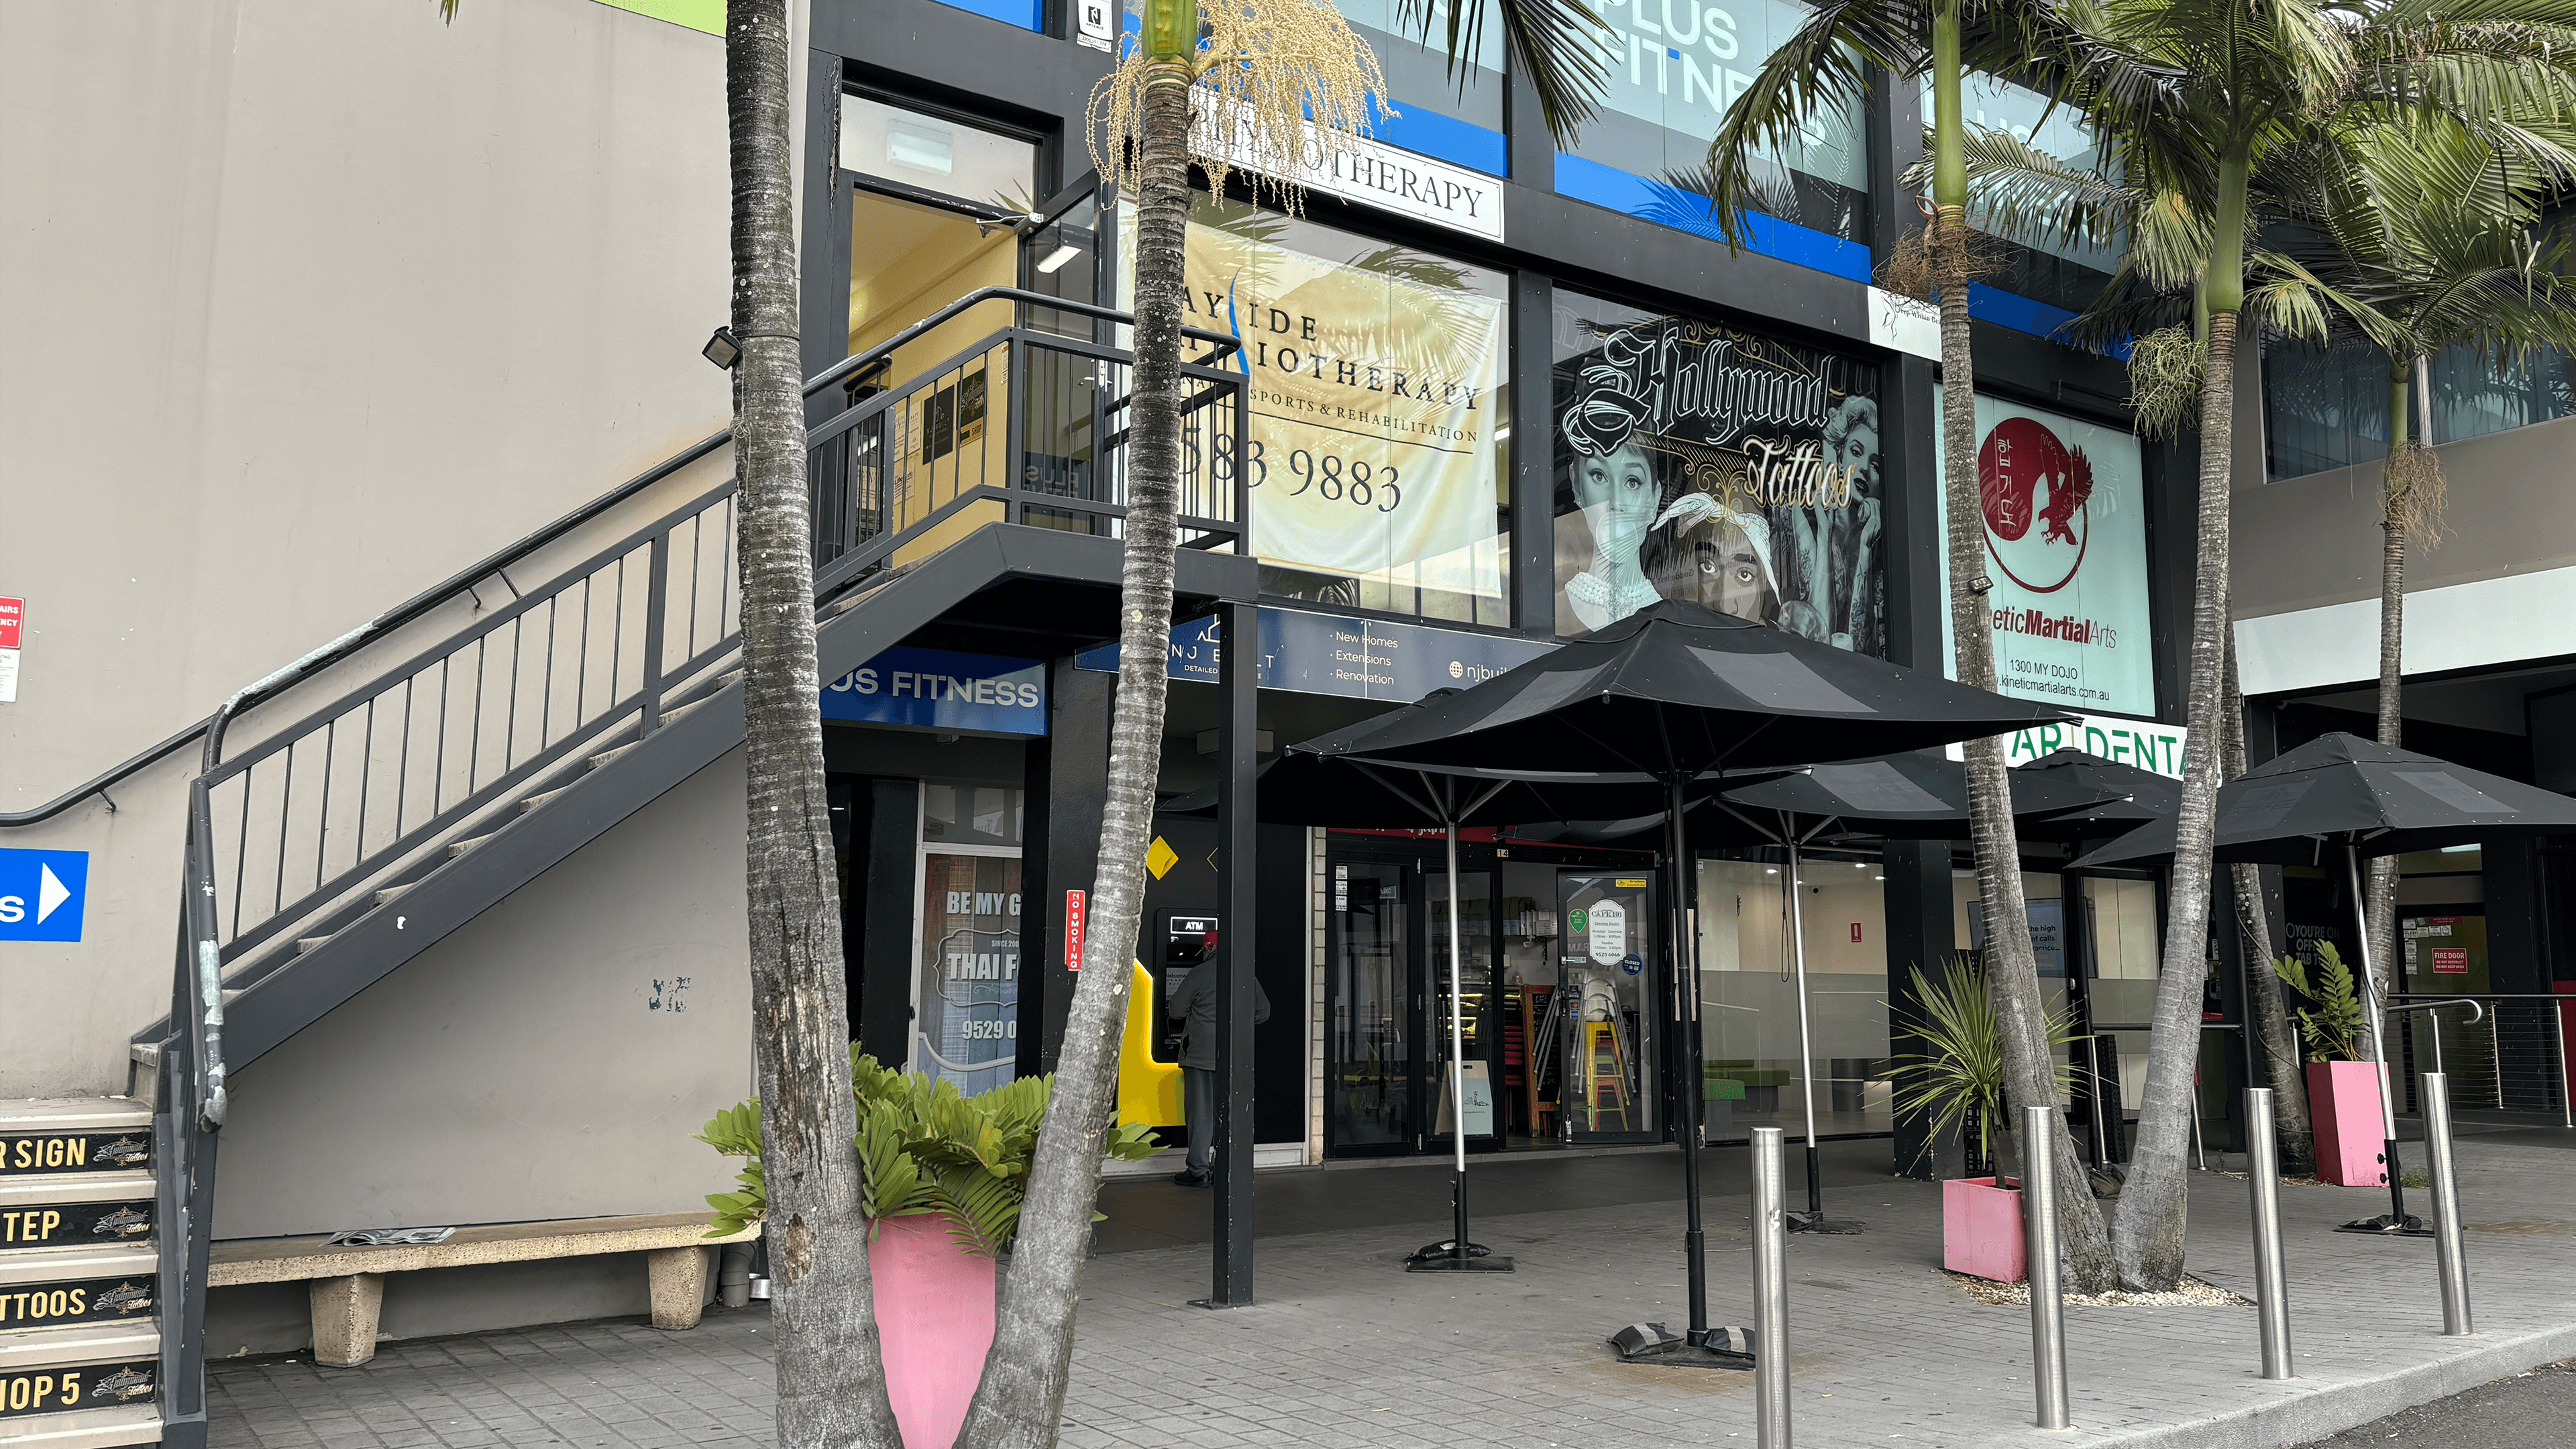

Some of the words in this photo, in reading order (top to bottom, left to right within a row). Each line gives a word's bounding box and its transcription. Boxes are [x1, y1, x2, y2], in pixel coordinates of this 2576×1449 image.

[1595, 0, 1739, 60] LUS
[1562, 326, 1835, 457] Hollywood
[1249, 388, 1315, 413] SPORTS
[1320, 406, 1331, 415] &
[1336, 406, 1479, 443] REHABILITATION
[1289, 448, 1402, 513] 9883
[1743, 435, 1857, 511] Tattoos
[0, 606, 19, 614] AIRS
[0, 618, 18, 627] NCY
[1336, 631, 1360, 643] New
[1362, 633, 1399, 649] Homes
[1991, 606, 2117, 649] eticMartialArts
[1184, 664, 1218, 674] DETAILED
[1336, 649, 1392, 666] Extensions
[2010, 659, 2032, 674] 1300
[2035, 661, 2049, 676] MY
[2051, 665, 2078, 680] DOJO
[892, 671, 1039, 708] FITNESS
[1336, 668, 1395, 686] Renovation
[1996, 674, 2110, 701] .kineticmartialarts.com.au
[2012, 724, 2062, 759] AR
[2086, 727, 2186, 775] DENT
[1498, 849, 1509, 857] 14
[947, 891, 971, 914] BE
[975, 892, 1006, 916] MY
[1071, 893, 1080, 909] NO
[1185, 921, 1203, 930] ATM
[2040, 924, 2056, 933] high
[991, 940, 1008, 948] SINCE
[1070, 912, 1080, 969] SMOKING
[947, 953, 1000, 980] THAI
[962, 1020, 1004, 1040] 9529
[14, 1138, 86, 1169] SIGN
[3, 1210, 60, 1242] TEP
[0, 1288, 87, 1322] TTOOS
[0, 1375, 54, 1411] OP
[61, 1372, 80, 1405] 5
